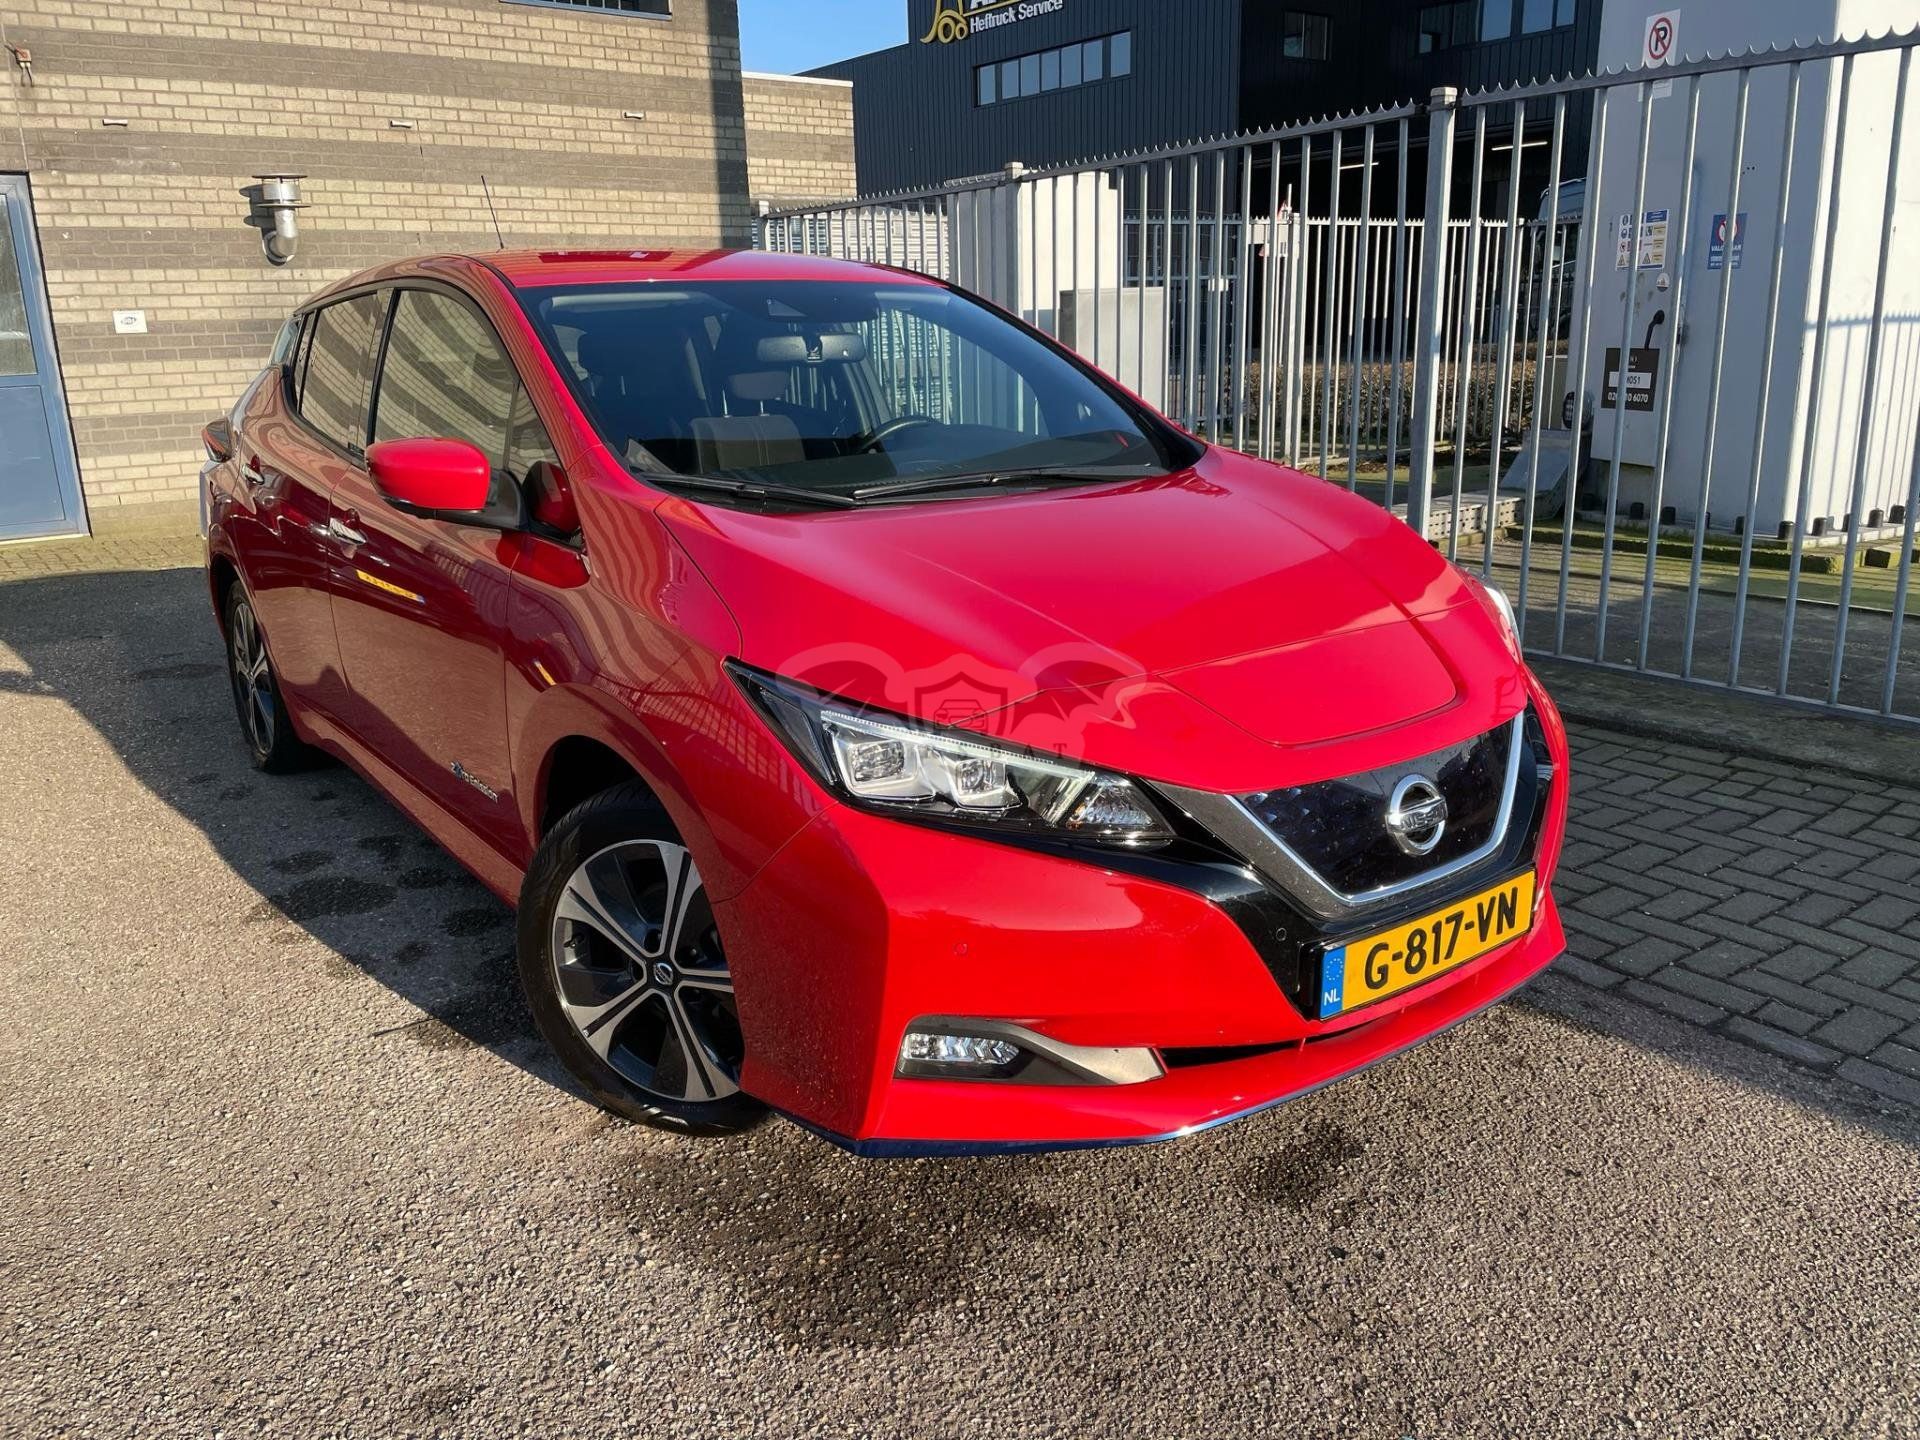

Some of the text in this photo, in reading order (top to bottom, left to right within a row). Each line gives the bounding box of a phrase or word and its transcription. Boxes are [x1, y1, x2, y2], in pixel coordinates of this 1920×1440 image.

[969, 0, 1063, 33] Heftruck Service
[1364, 886, 1519, 990] G-817-VN
[1324, 988, 1341, 1005] NL
